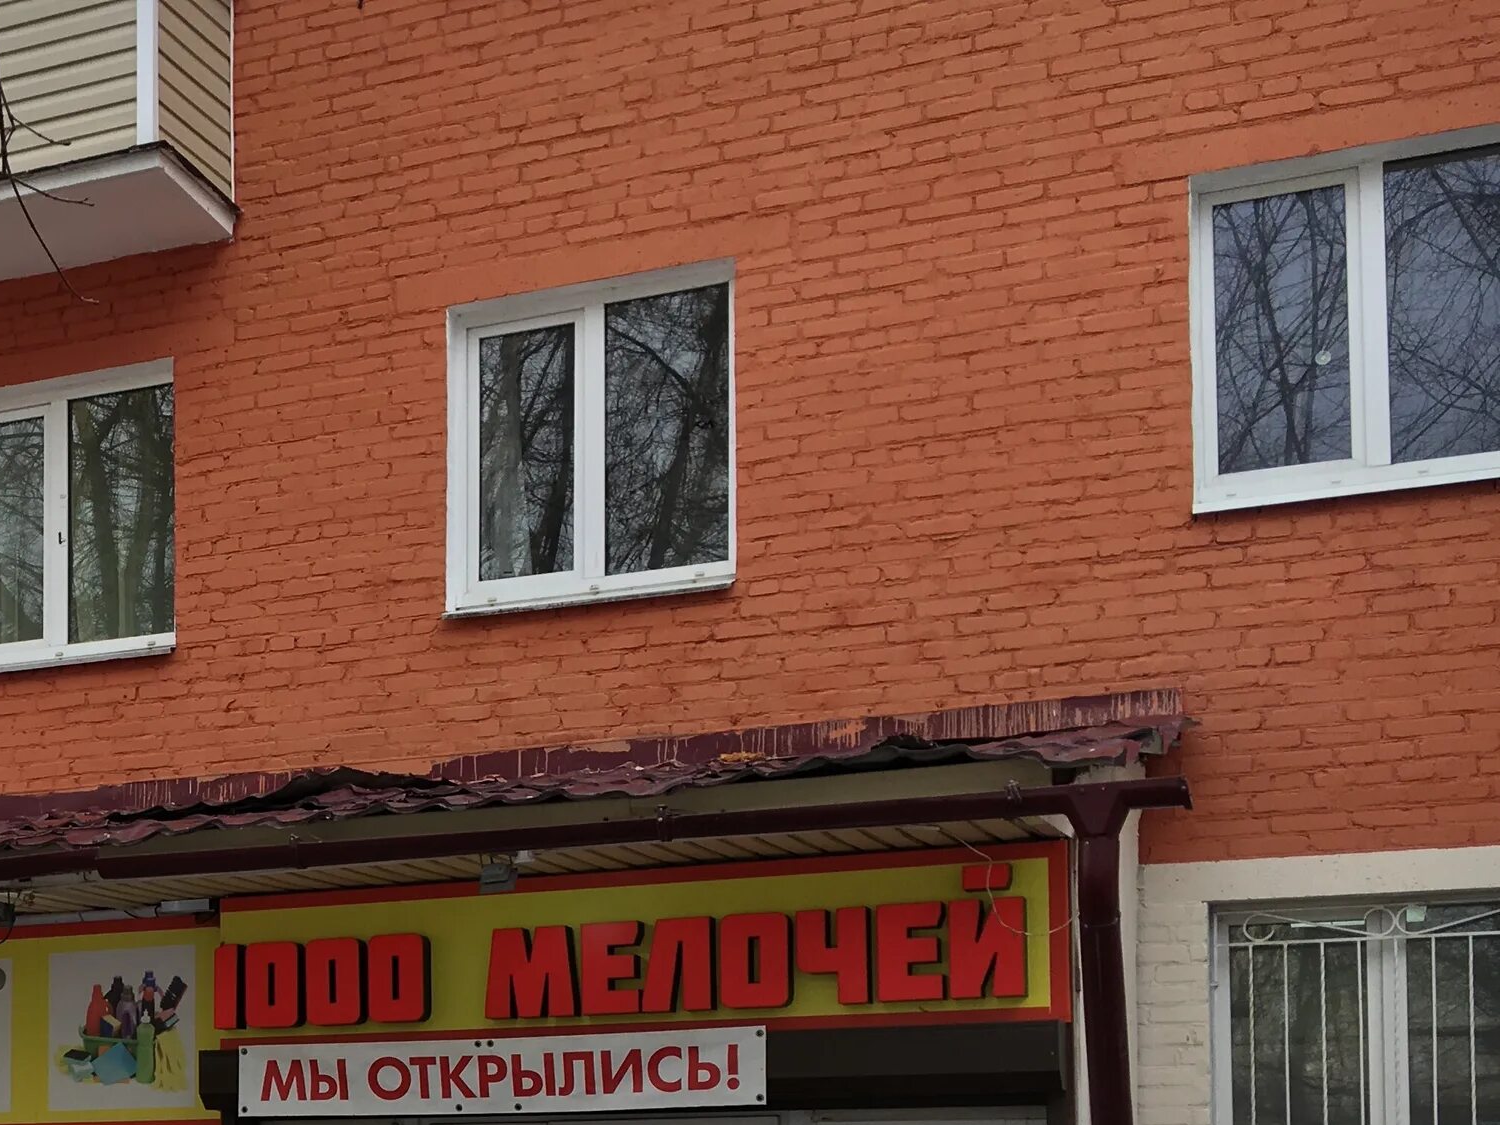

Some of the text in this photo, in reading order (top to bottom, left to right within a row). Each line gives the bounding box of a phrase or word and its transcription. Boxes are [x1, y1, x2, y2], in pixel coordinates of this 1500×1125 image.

[214, 862, 1028, 1030] 1000 МЕЛОЧЕЙ
[260, 1043, 741, 1102] МЫ ОТКРЫЛИСЬ!
